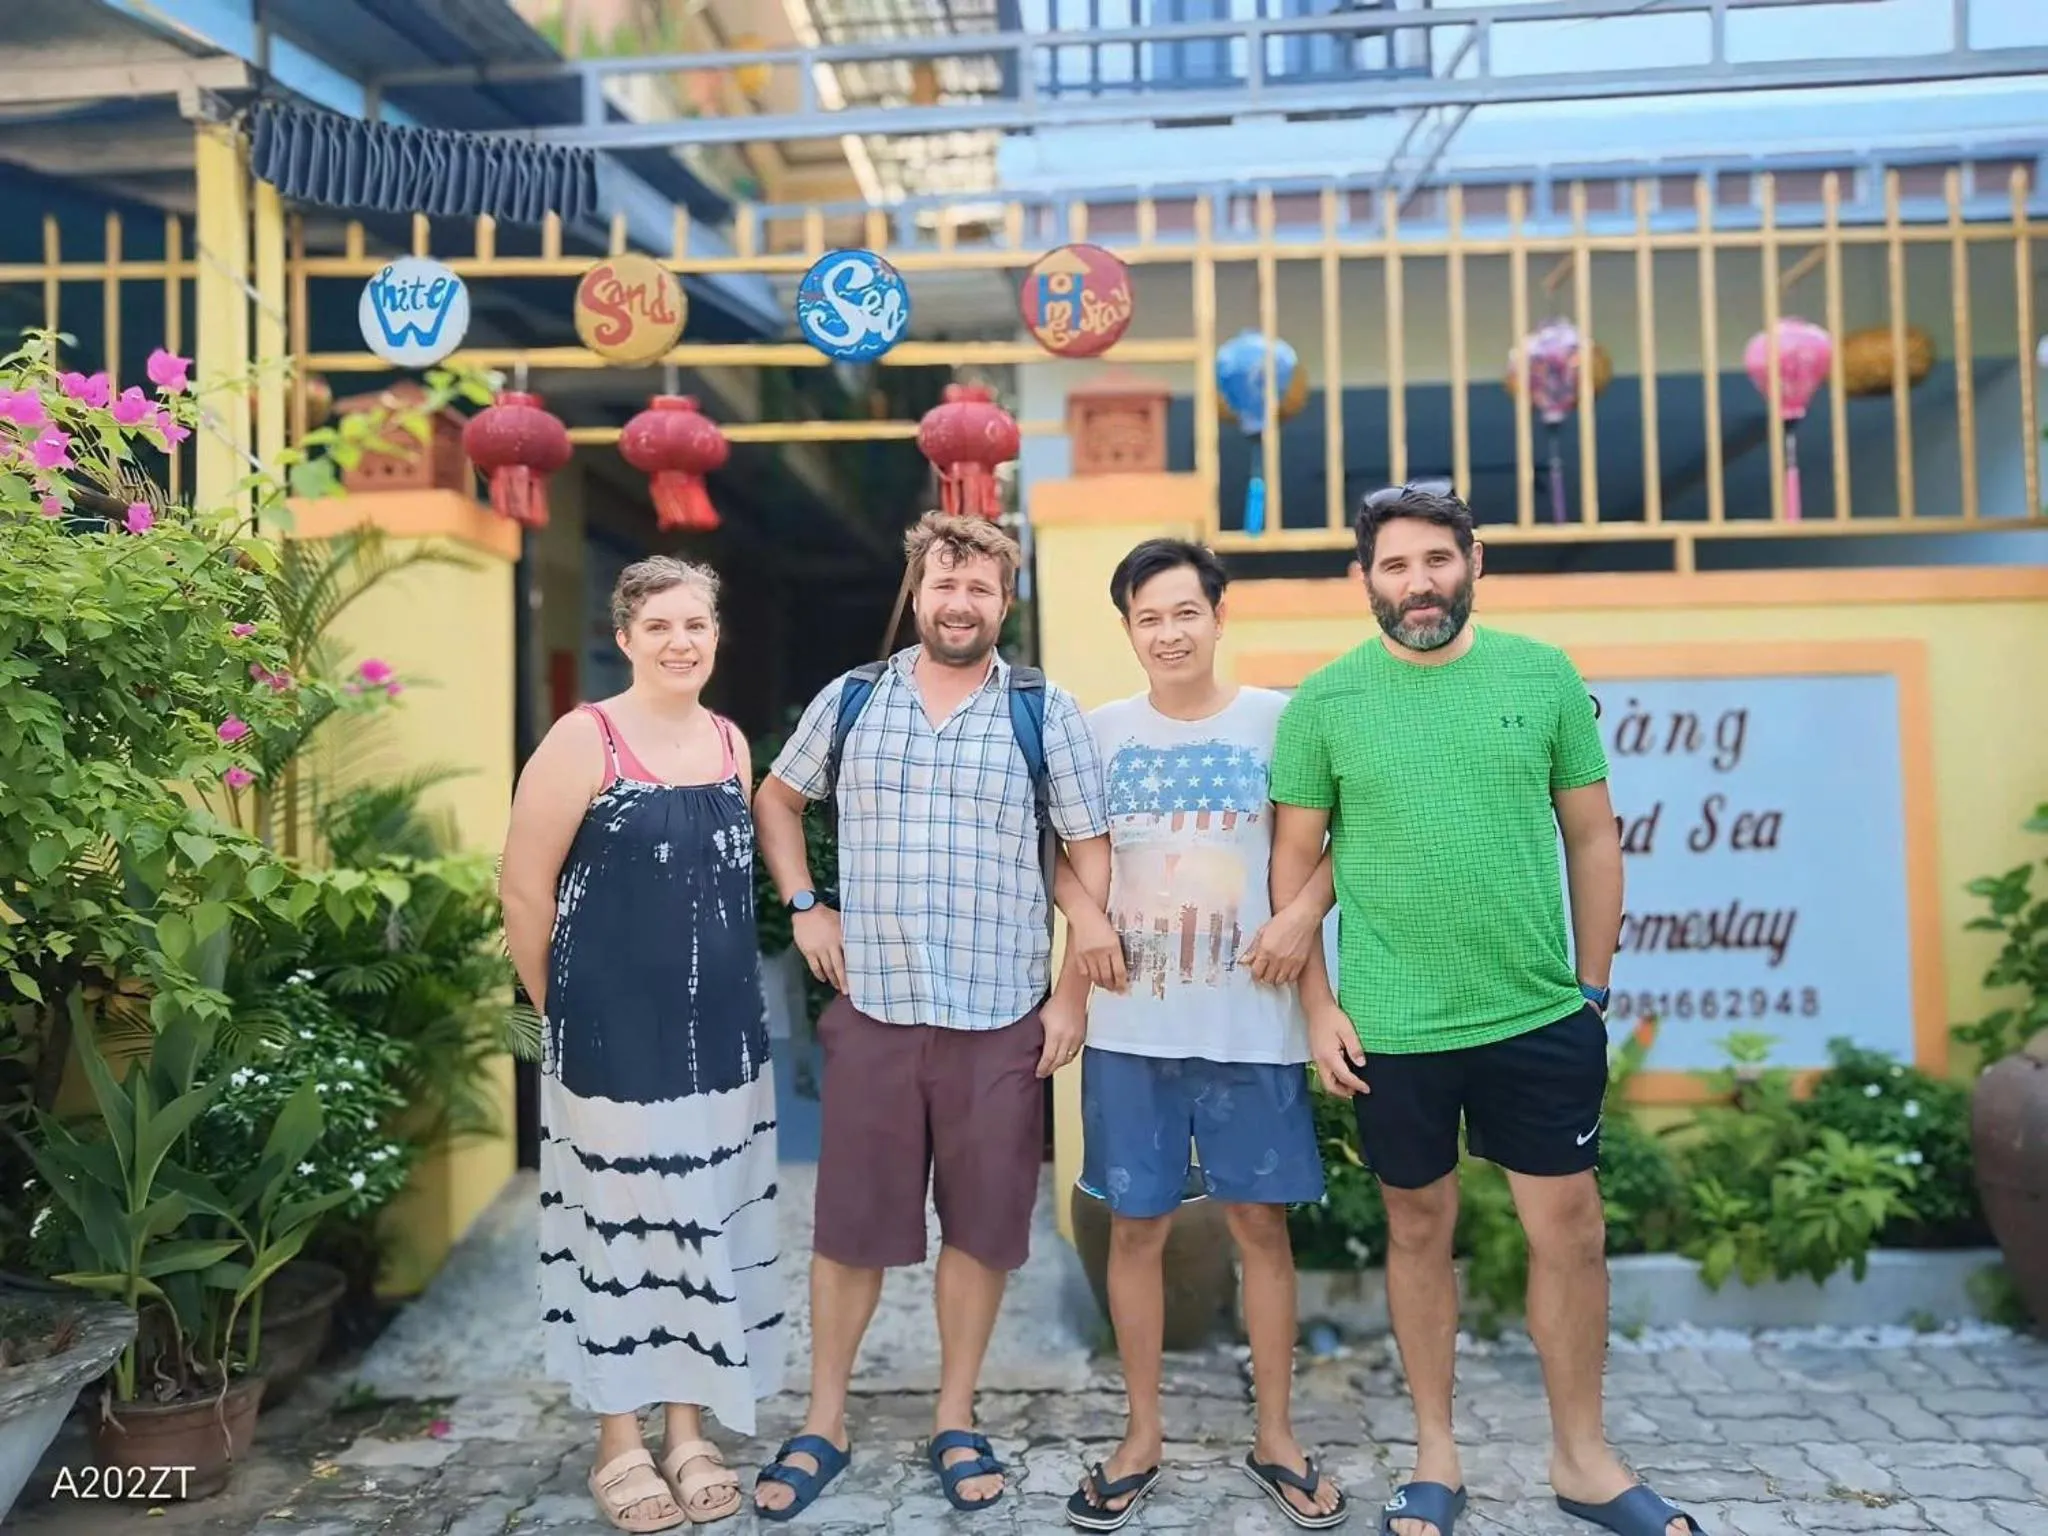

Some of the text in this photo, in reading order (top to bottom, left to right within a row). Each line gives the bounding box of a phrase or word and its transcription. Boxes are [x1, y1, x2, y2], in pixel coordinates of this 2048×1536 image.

[579, 266, 676, 346] Sand
[806, 259, 907, 347] Sea
[1588, 694, 1748, 772] àng
[1688, 793, 1784, 853] Sea
